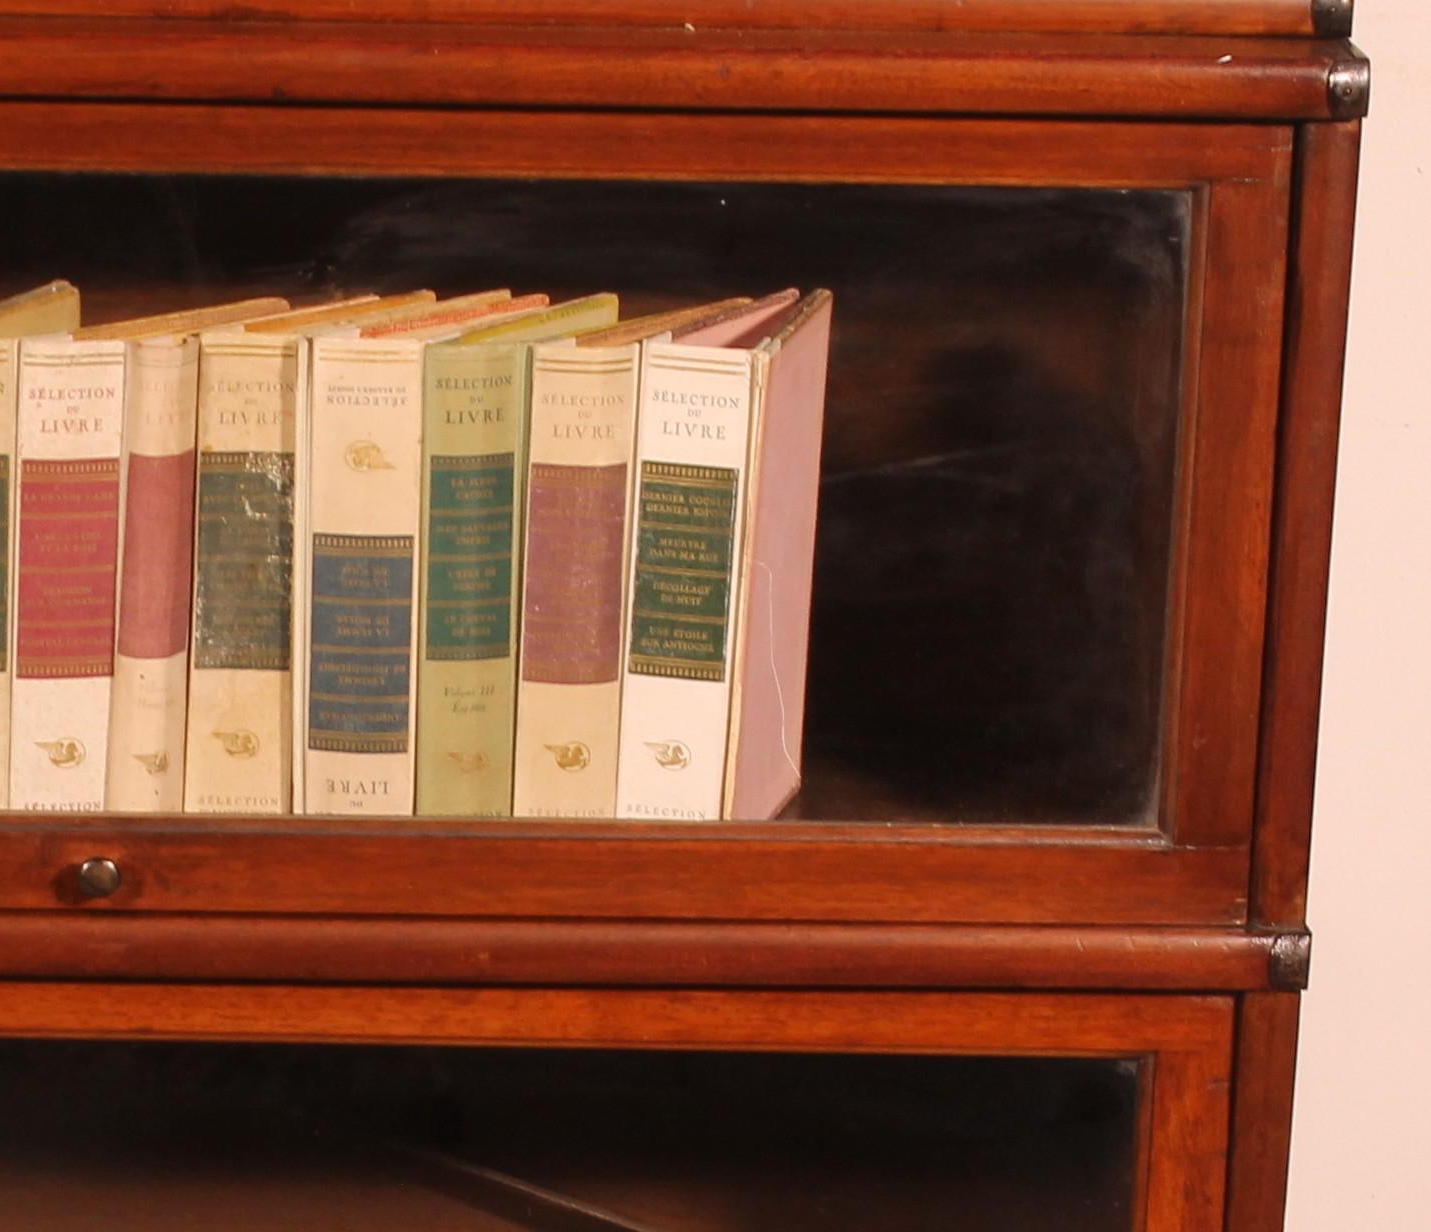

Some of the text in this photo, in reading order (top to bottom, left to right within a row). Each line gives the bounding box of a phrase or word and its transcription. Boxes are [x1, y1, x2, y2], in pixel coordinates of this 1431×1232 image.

[435, 375, 512, 389] SÉLECTION
[28, 386, 116, 400] SÉLECTION
[542, 393, 625, 408] SÉLECTION
[652, 389, 740, 409] SÉLECTION
[445, 408, 506, 424] LIVRE
[687, 408, 702, 418] DU
[41, 418, 105, 434] LIVRE
[553, 424, 615, 439] LIVRE
[662, 421, 726, 440] LIVRE
[327, 778, 389, 795] LIVRE
[626, 804, 707, 819] SÉLECTION
